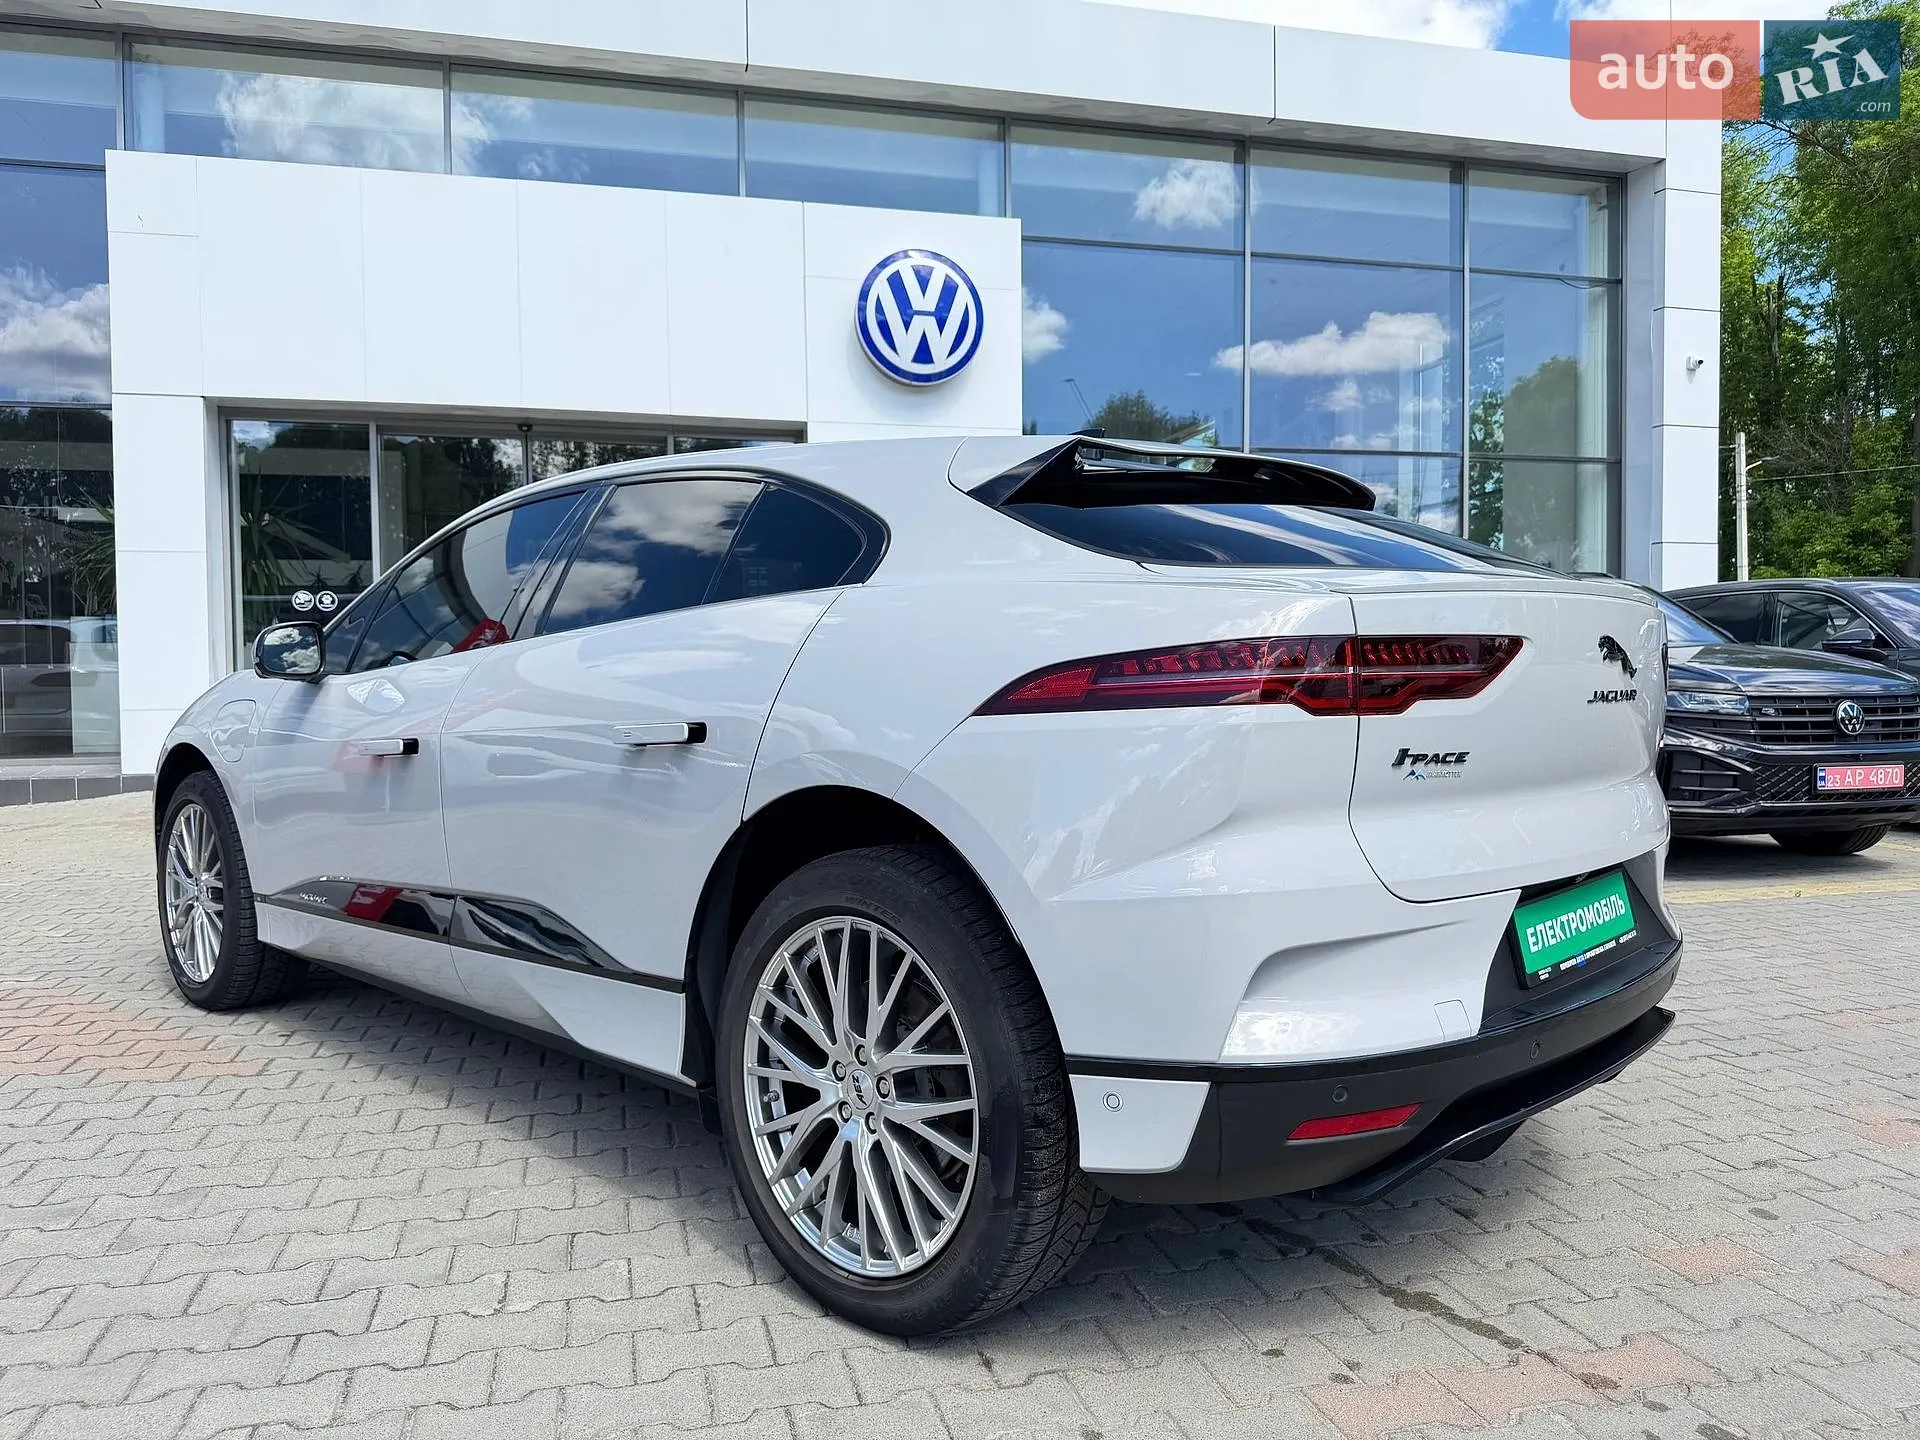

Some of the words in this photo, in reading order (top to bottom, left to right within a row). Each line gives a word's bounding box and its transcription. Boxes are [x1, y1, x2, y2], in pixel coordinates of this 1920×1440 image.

[1587, 689, 1637, 704] JAGUAR
[1827, 775, 1840, 787] 23
[1844, 769, 1865, 785] AP
[1869, 768, 1900, 785] 4870
[843, 895, 904, 925] WINTER
[1525, 893, 1626, 953] ЕЛЕКТРОМОБІЛЬ
[851, 1074, 868, 1106] AEZ
